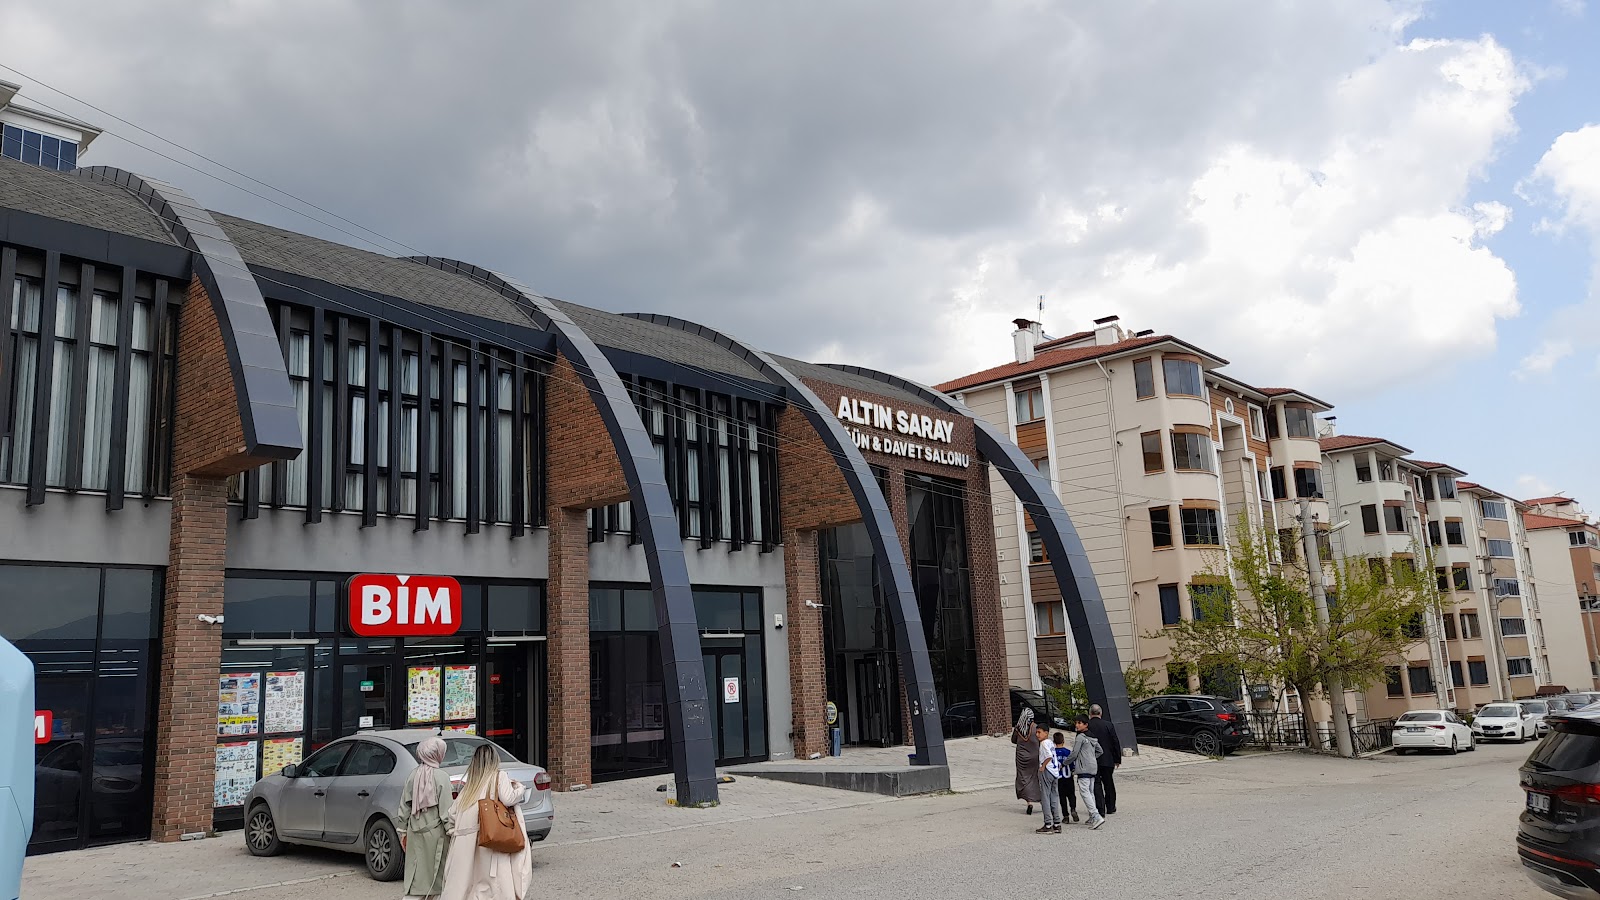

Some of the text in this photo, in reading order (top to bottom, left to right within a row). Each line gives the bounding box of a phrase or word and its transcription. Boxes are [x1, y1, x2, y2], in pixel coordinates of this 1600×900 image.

[838, 396, 953, 443] ALTIN SARAY
[872, 435, 883, 452] &
[884, 438, 923, 459] DAVET
[925, 447, 969, 468] SALONU
[361, 575, 452, 625] BİM
